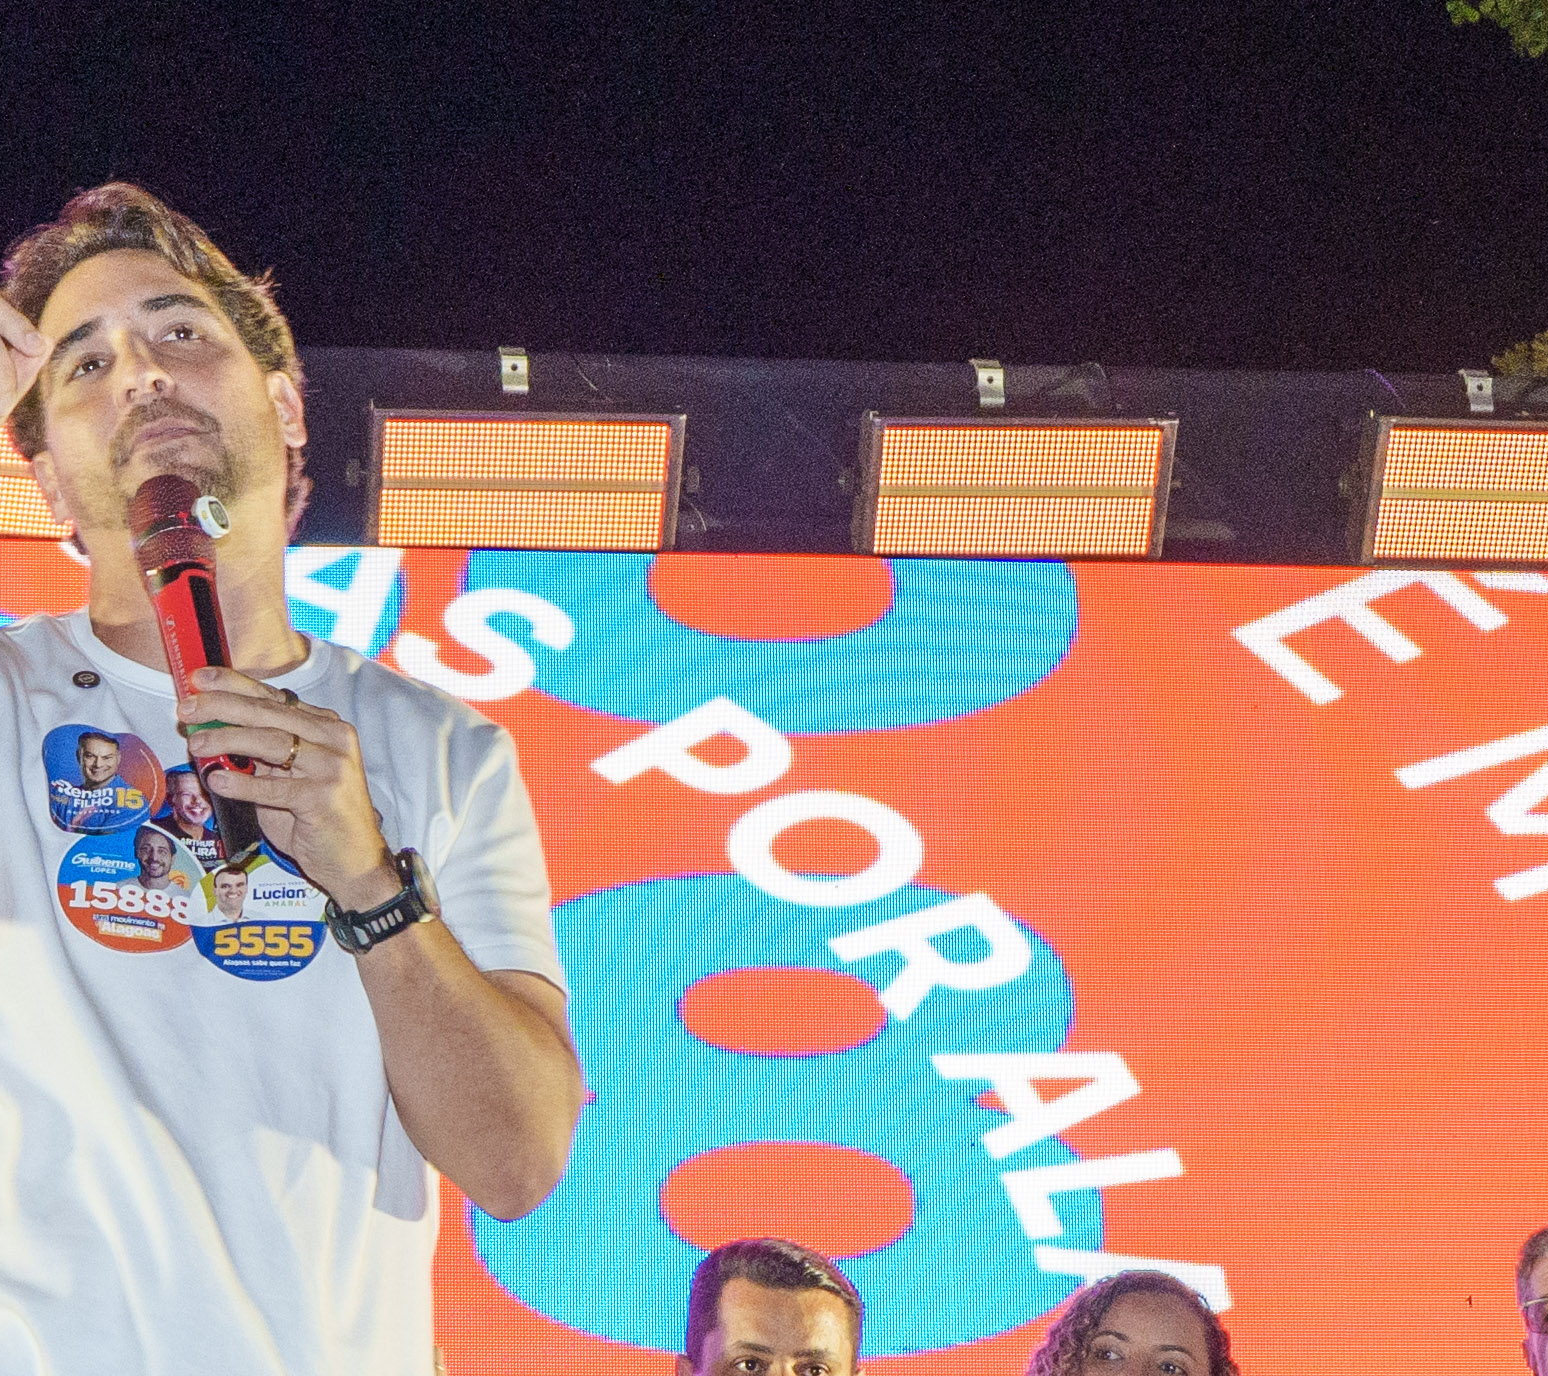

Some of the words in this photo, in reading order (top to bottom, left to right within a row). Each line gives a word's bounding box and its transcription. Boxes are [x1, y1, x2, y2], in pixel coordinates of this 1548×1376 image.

[52, 780, 114, 799] Renan
[285, 546, 576, 702] AS
[592, 695, 1033, 1022] POR
[73, 797, 114, 809] FILHO
[115, 787, 144, 810] 15
[72, 853, 136, 871] Guilherme
[90, 866, 117, 875] LOPES
[68, 880, 191, 925] 15888
[214, 925, 315, 958] 5555
